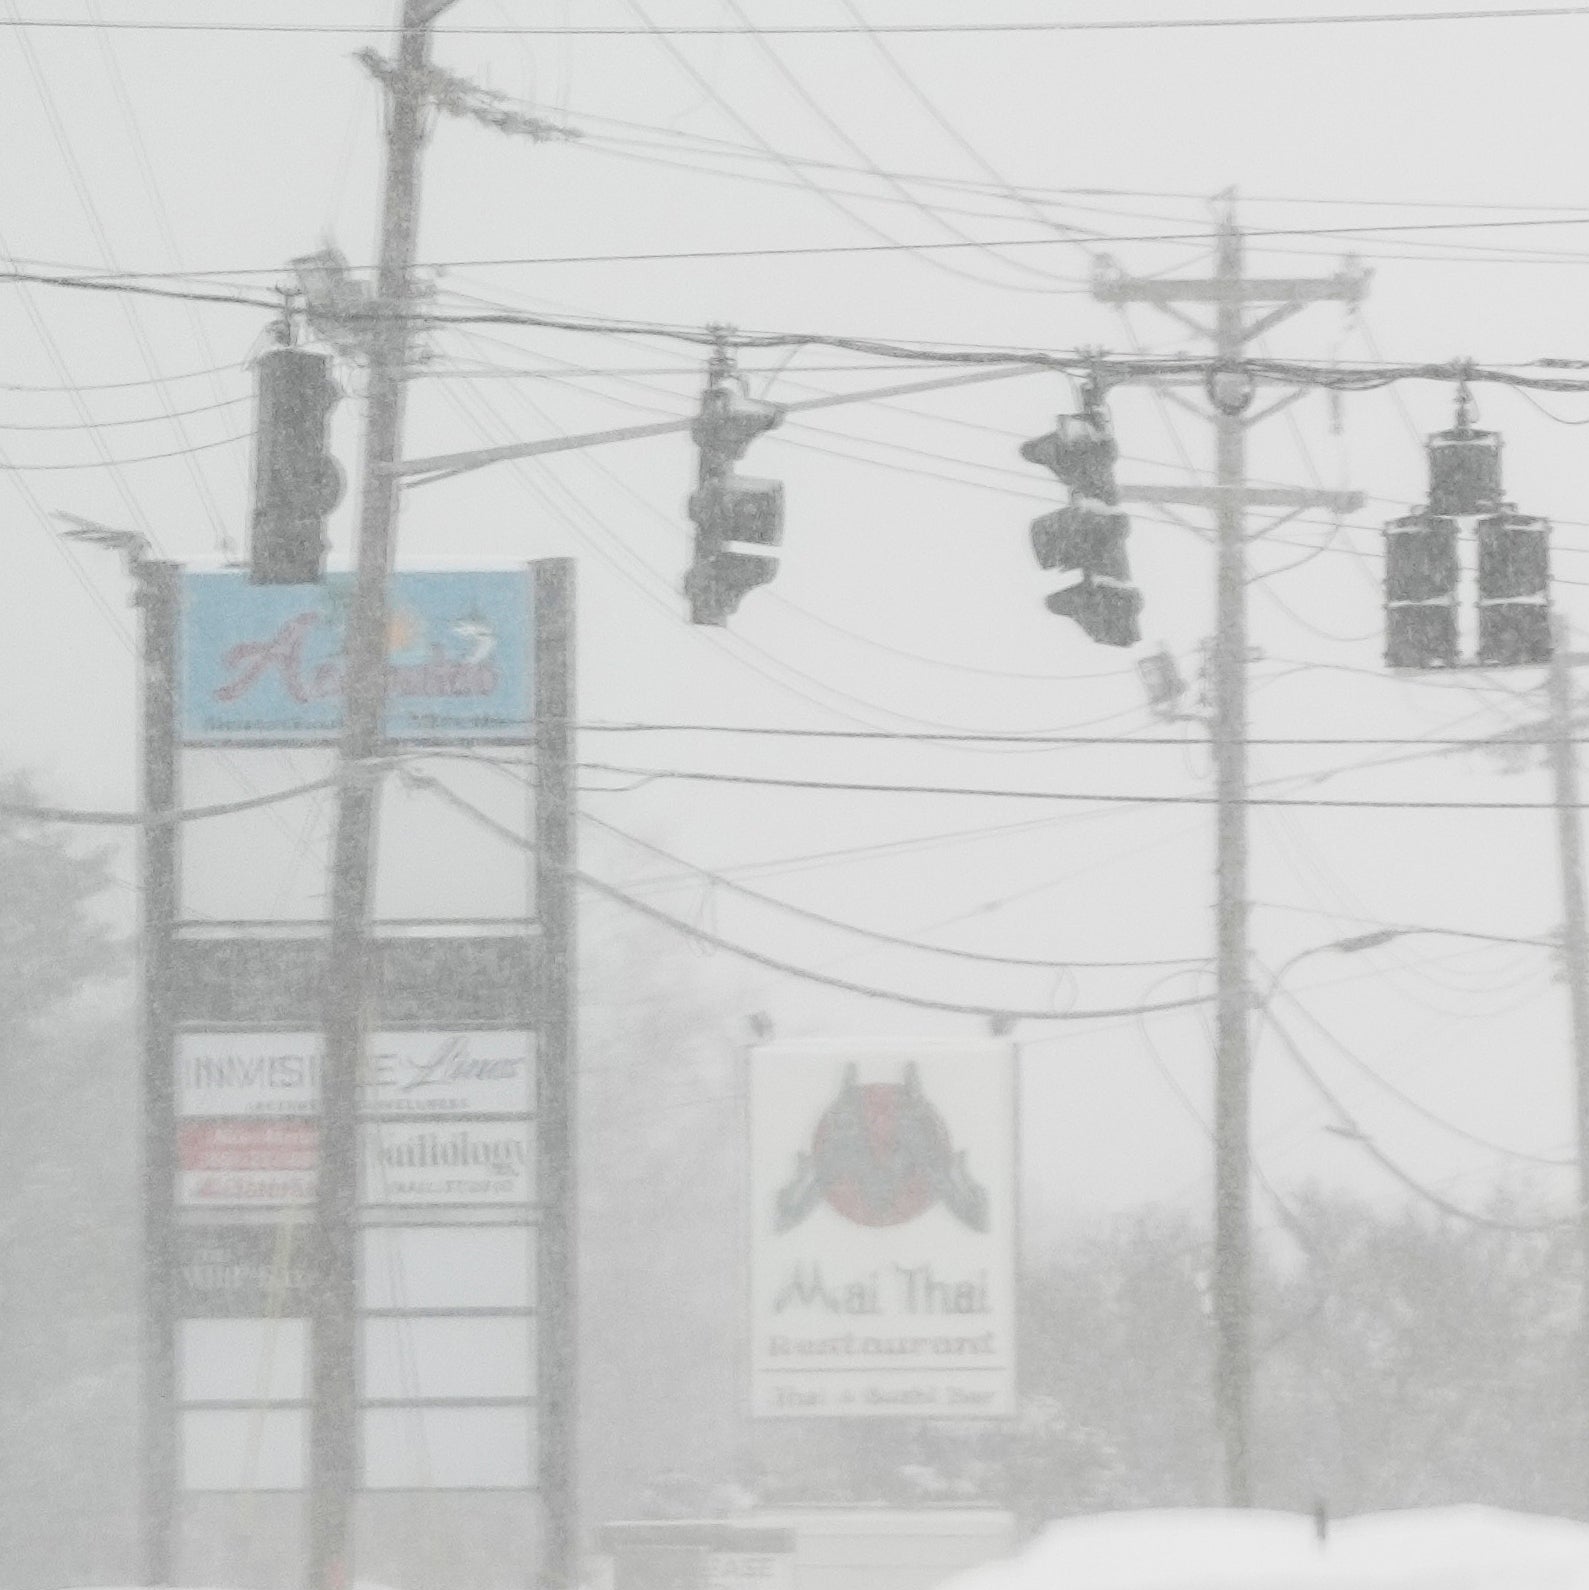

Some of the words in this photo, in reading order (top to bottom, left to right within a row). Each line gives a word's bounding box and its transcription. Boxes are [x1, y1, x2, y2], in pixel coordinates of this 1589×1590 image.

[772, 1258, 881, 1315] Mai
[891, 1260, 992, 1315] Thai
[767, 1331, 996, 1357] Restaurant
